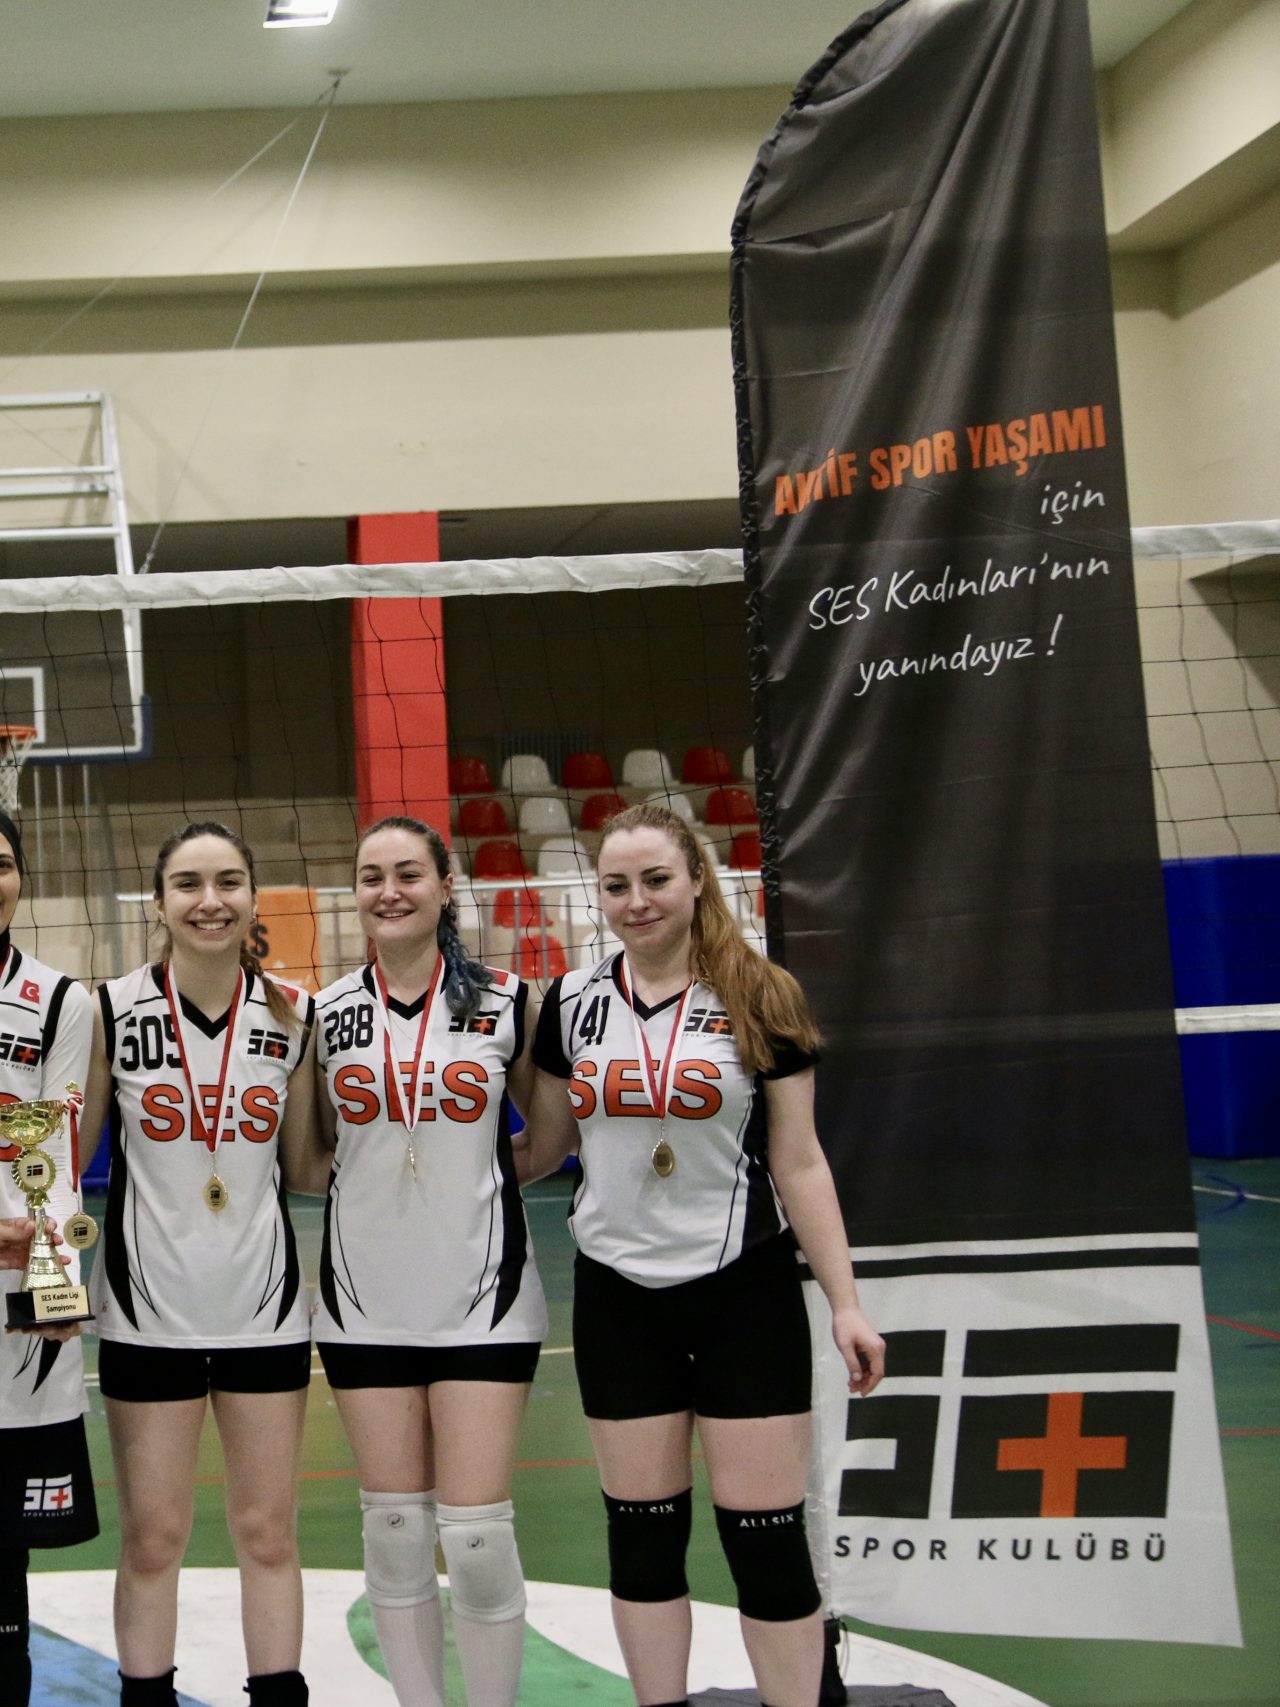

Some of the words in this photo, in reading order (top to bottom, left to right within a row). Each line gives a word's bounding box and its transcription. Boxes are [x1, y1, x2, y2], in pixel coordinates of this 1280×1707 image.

[868, 429, 958, 490] SPOR
[966, 405, 1107, 477] YAŞAMI
[1040, 480, 1106, 525] için
[808, 577, 878, 631] SES
[853, 632, 1035, 697] yanındayız
[119, 1013, 185, 1072] 505
[323, 1003, 374, 1058] 288
[578, 994, 611, 1046] 41
[140, 1083, 280, 1144] SES
[333, 1060, 490, 1126] SES
[569, 1058, 724, 1121] SES
[834, 1535, 949, 1561] SPOR
[977, 1532, 1167, 1563] KULÜBÜ
